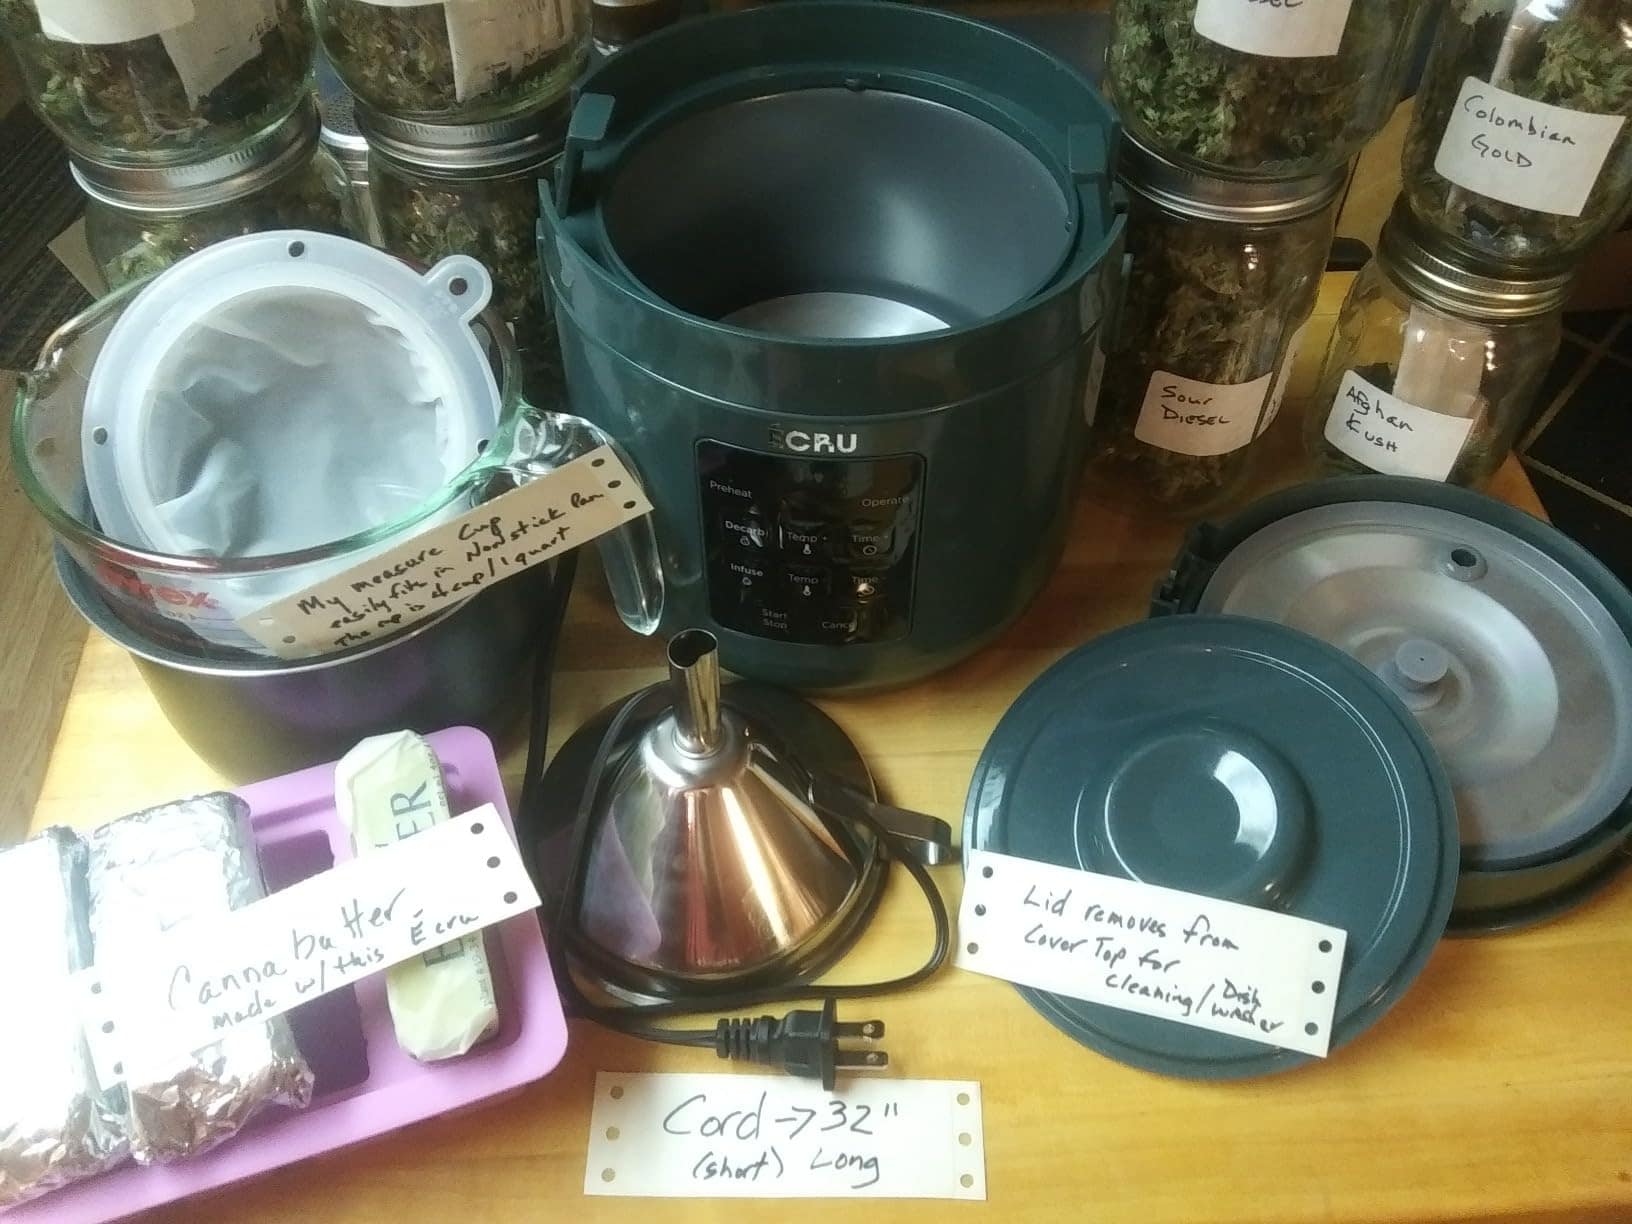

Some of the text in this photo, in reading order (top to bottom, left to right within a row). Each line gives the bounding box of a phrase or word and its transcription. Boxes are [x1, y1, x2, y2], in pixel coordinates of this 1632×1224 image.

[1464, 95, 1576, 146] Colombian
[1471, 133, 1532, 168] GOLD
[1160, 385, 1213, 405] Sour
[1346, 385, 1414, 432] Afghan
[709, 479, 753, 499] Preheat
[787, 531, 819, 544] Temp
[852, 534, 881, 543] Time
[297, 595, 353, 616] My
[350, 548, 442, 593] measure
[730, 562, 764, 578] Infuse
[788, 573, 820, 586] Temp
[334, 631, 371, 647] The
[1023, 884, 1240, 951] Lid removes from
[1095, 936, 1127, 969] Top
[662, 1090, 768, 1141] Cord
